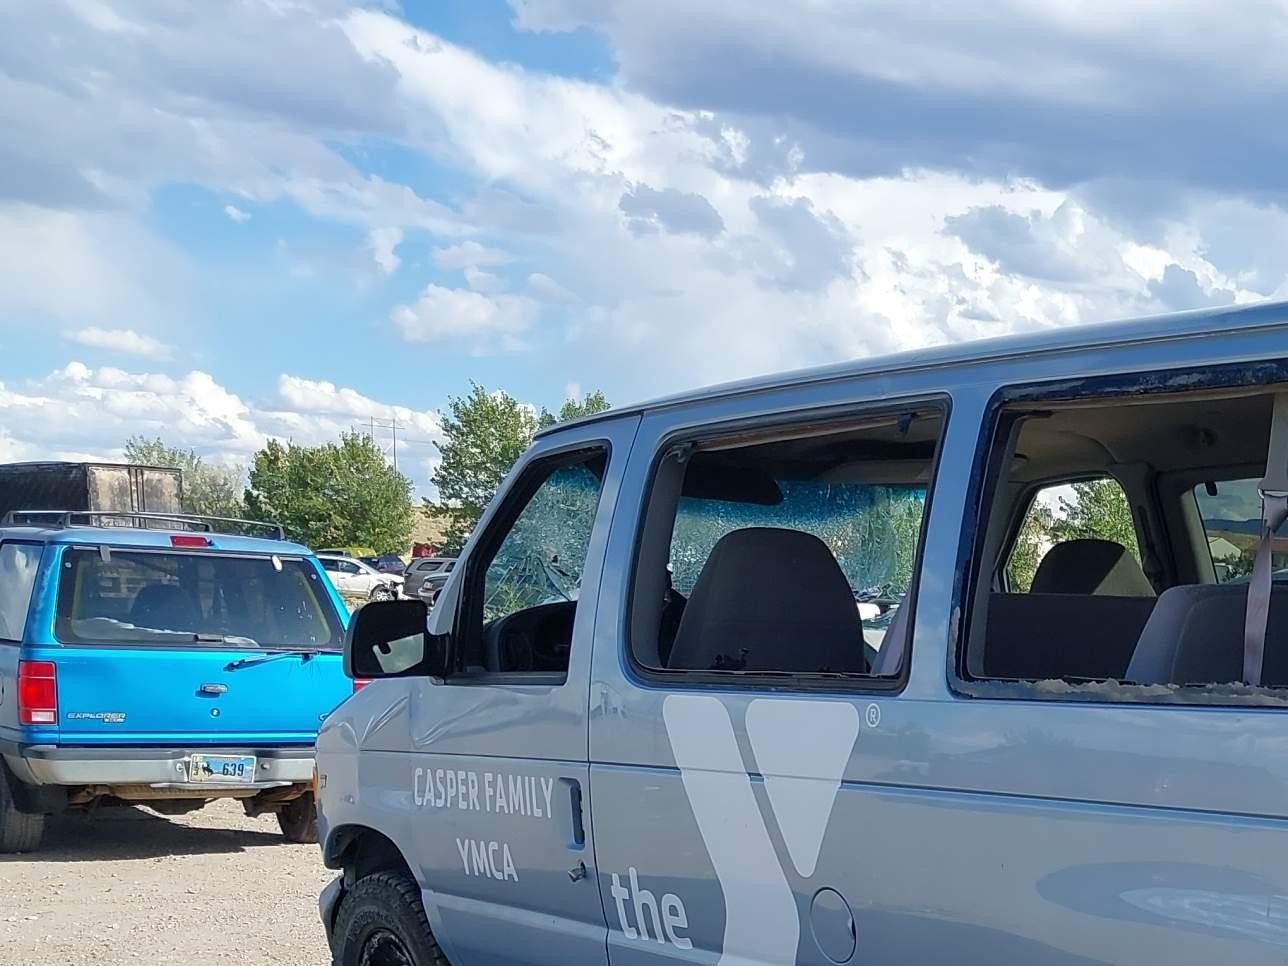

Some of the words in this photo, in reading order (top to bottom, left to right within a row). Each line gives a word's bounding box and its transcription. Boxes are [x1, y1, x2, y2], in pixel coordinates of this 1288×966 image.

[67, 712, 126, 720] EXPLORER
[222, 762, 245, 776] 639
[414, 767, 480, 811] CASPER
[484, 772, 553, 819] FAMILY
[456, 837, 519, 882] YMCA
[610, 867, 693, 950] the
